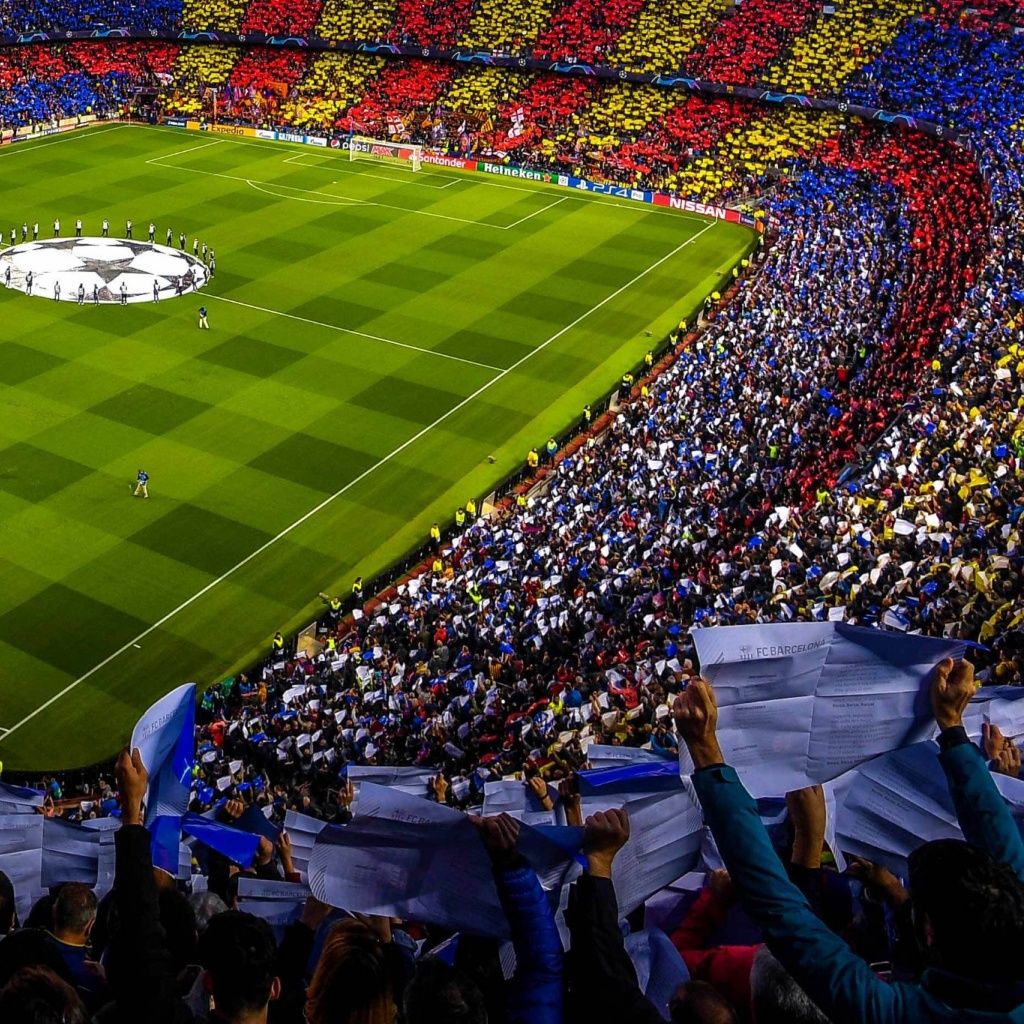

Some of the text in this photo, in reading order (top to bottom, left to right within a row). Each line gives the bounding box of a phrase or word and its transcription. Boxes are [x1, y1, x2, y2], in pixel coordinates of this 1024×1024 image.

[212, 125, 244, 136] Expedia
[342, 141, 370, 153] pepsi
[418, 151, 466, 169] Santander
[484, 162, 541, 181] Heineken
[592, 183, 629, 198] PS4
[669, 197, 727, 220] NISSAN
[756, 639, 826, 658] FC BARCELONA
